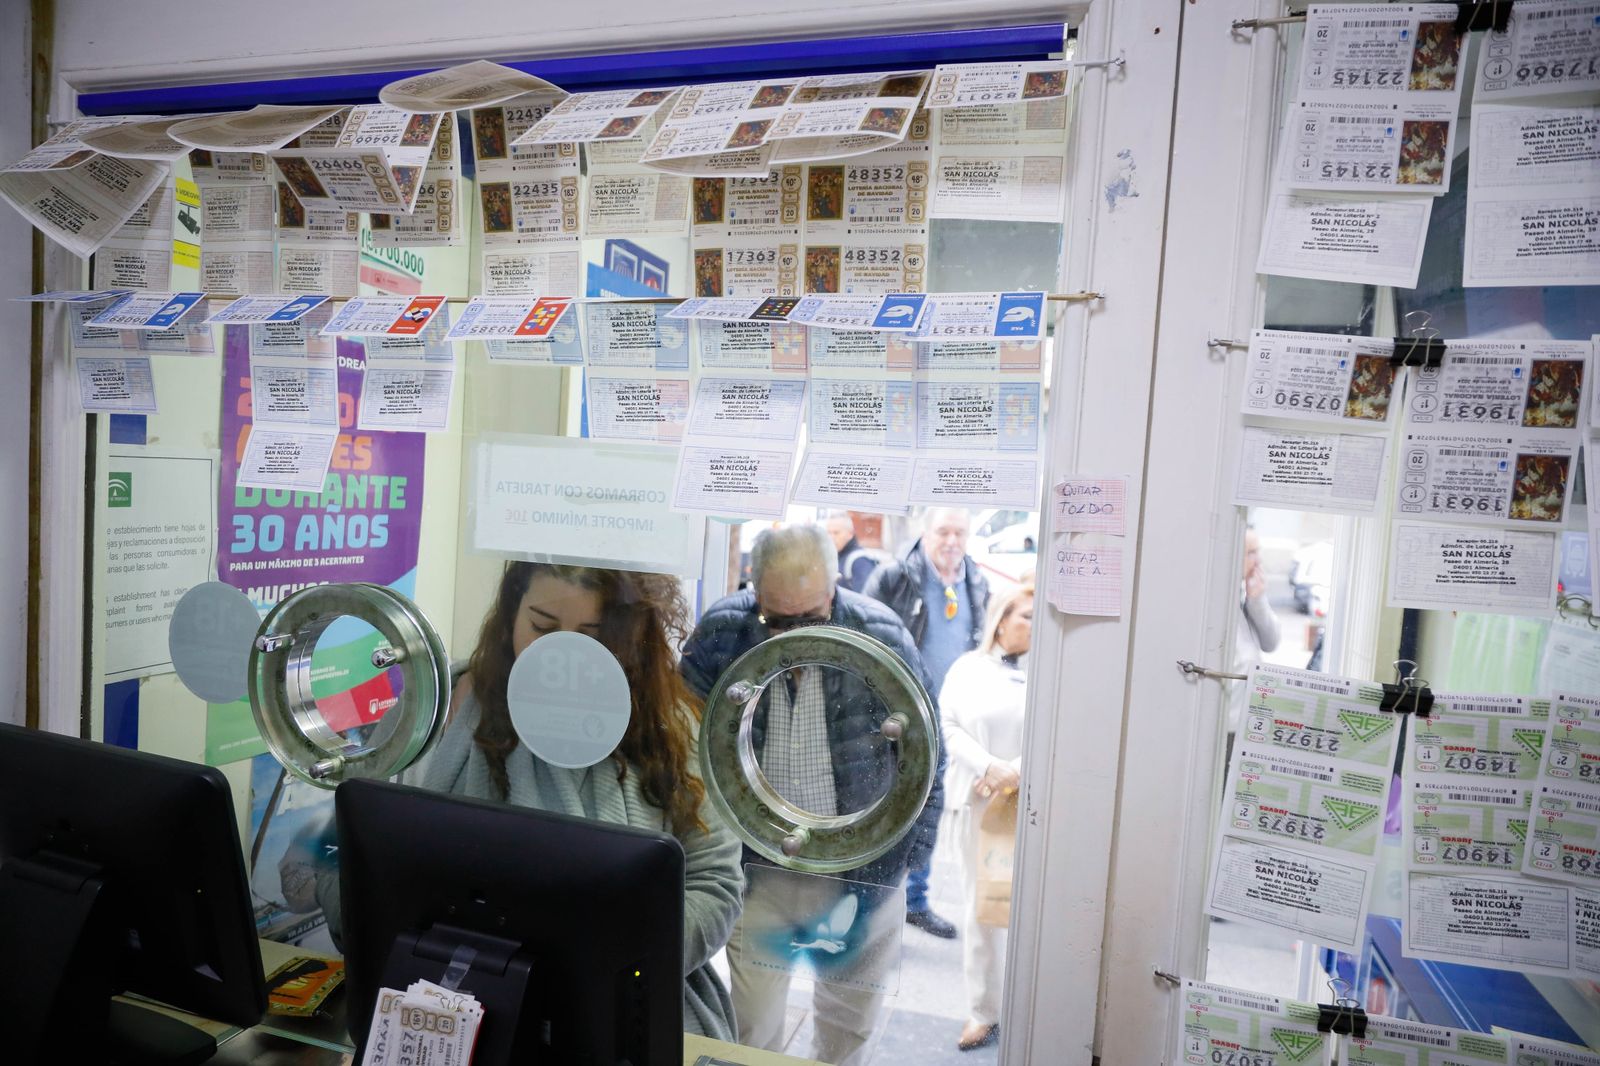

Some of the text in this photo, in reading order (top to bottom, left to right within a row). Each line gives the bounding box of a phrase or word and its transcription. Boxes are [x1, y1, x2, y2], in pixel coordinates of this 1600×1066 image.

[1516, 60, 1596, 81] 17966
[1333, 71, 1403, 85] 22145
[1522, 131, 1544, 140] SAN
[312, 159, 363, 169] 26466
[848, 168, 903, 180] 48352
[1322, 163, 1391, 178] 22145
[513, 183, 558, 195] 22435
[1523, 222, 1545, 230] SAN
[727, 251, 775, 261] 17363
[845, 250, 900, 261] 48352
[1275, 392, 1340, 410] 07590
[1443, 406, 1515, 420] 19631
[1062, 485, 1102, 496] QUITAR
[1060, 502, 1114, 515] TOLDO
[1432, 495, 1502, 511] 19631
[114, 526, 161, 535] establecimiento
[182, 525, 196, 533] hojas
[231, 505, 389, 553] 30 AÑOS
[123, 538, 167, 547] reclamaciones
[174, 536, 205, 544] disposición
[110, 552, 118, 560] las
[123, 551, 152, 560] personas
[157, 549, 197, 557] consumidoras
[1057, 551, 1098, 564] QUITAR
[123, 565, 135, 573] que
[136, 562, 145, 570] las
[147, 562, 169, 570] solicite.
[230, 562, 253, 571] PARA
[255, 561, 266, 569] UN
[304, 558, 313, 567] DE
[321, 556, 364, 566] ACERTANTES
[1059, 567, 1086, 575] AIRE
[114, 591, 156, 602] establishment
[136, 604, 152, 612] forms
[136, 616, 150, 624] users
[1274, 719, 1304, 730] Jueves
[1272, 730, 1339, 752] 21975
[1444, 757, 1517, 773] 14907
[1259, 805, 1289, 817] Jueves
[1258, 816, 1325, 839] 21975
[1441, 836, 1472, 844] Jueves
[1442, 845, 1513, 865] 14907
[1255, 866, 1274, 875] SAN
[1452, 898, 1522, 910] SAN NICOLÁS
[1211, 1039, 1241, 1051] Jueves
